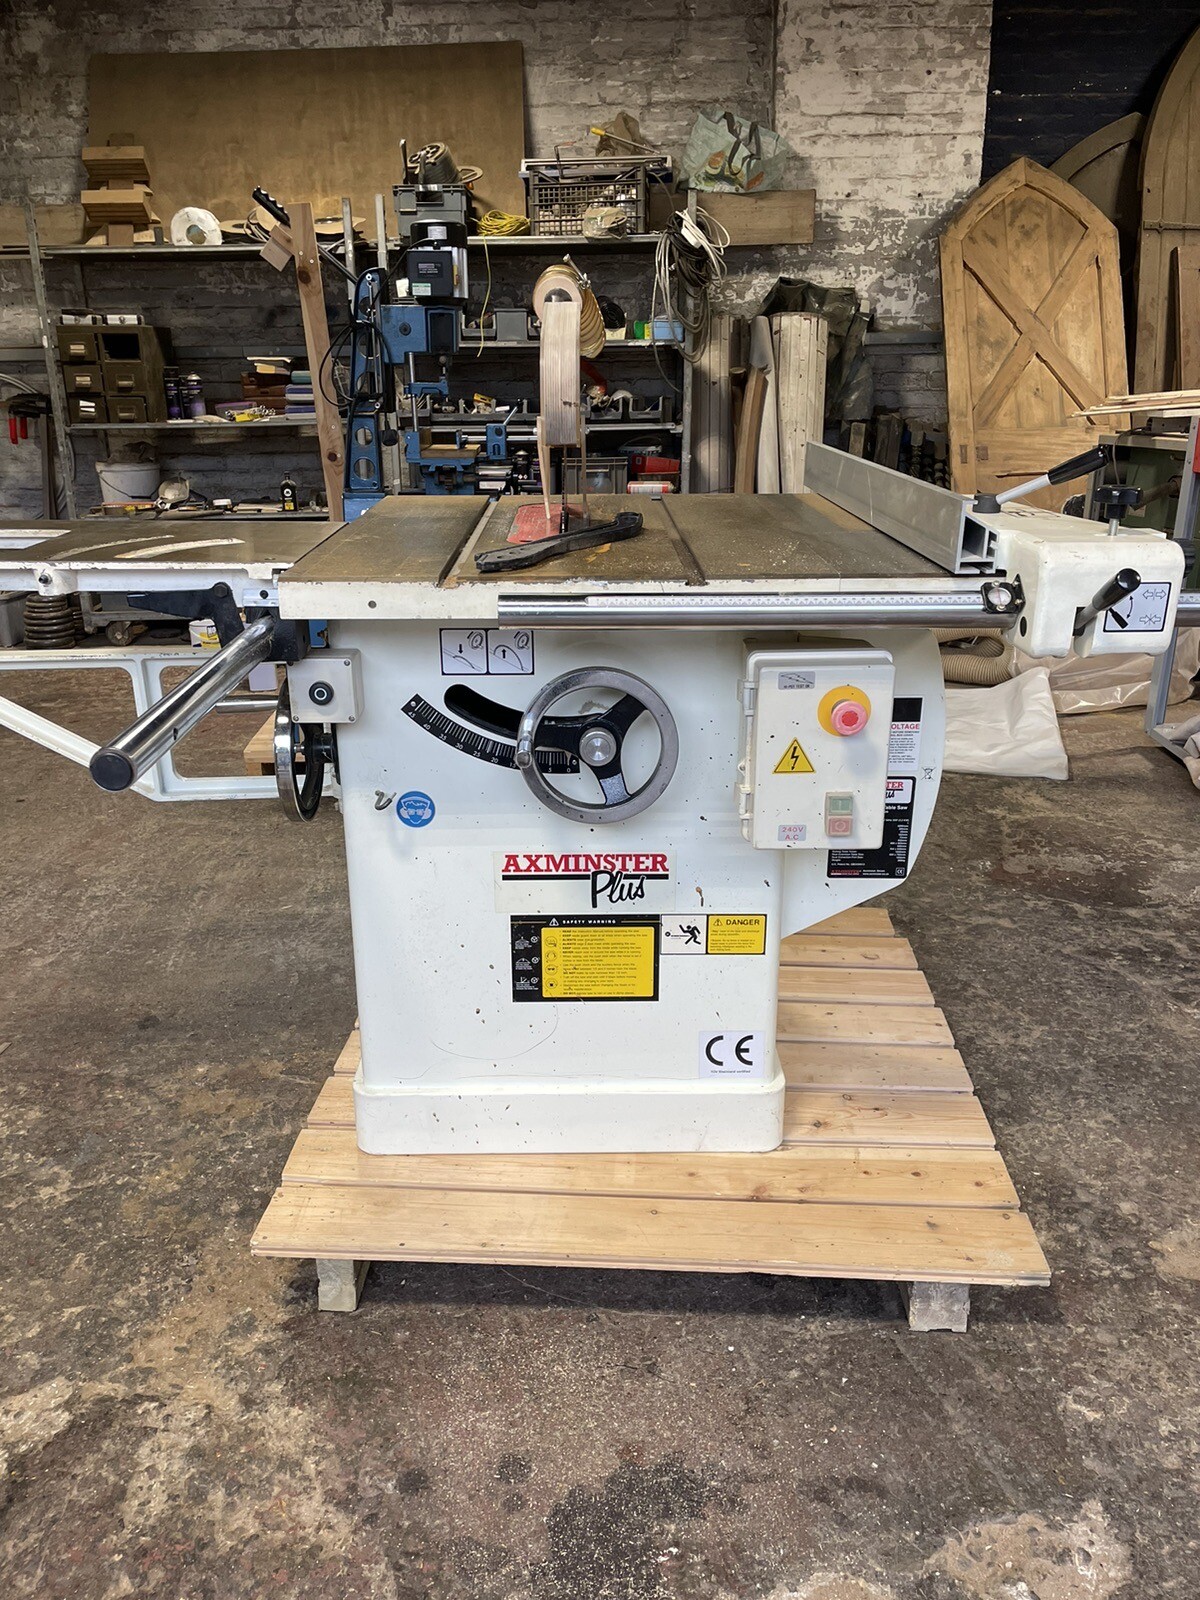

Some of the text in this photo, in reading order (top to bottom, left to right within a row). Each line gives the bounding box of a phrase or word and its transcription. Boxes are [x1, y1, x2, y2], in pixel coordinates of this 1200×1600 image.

[501, 853, 670, 872] AXMINSTER
[591, 870, 646, 908] Plus
[705, 1034, 754, 1066] CE
